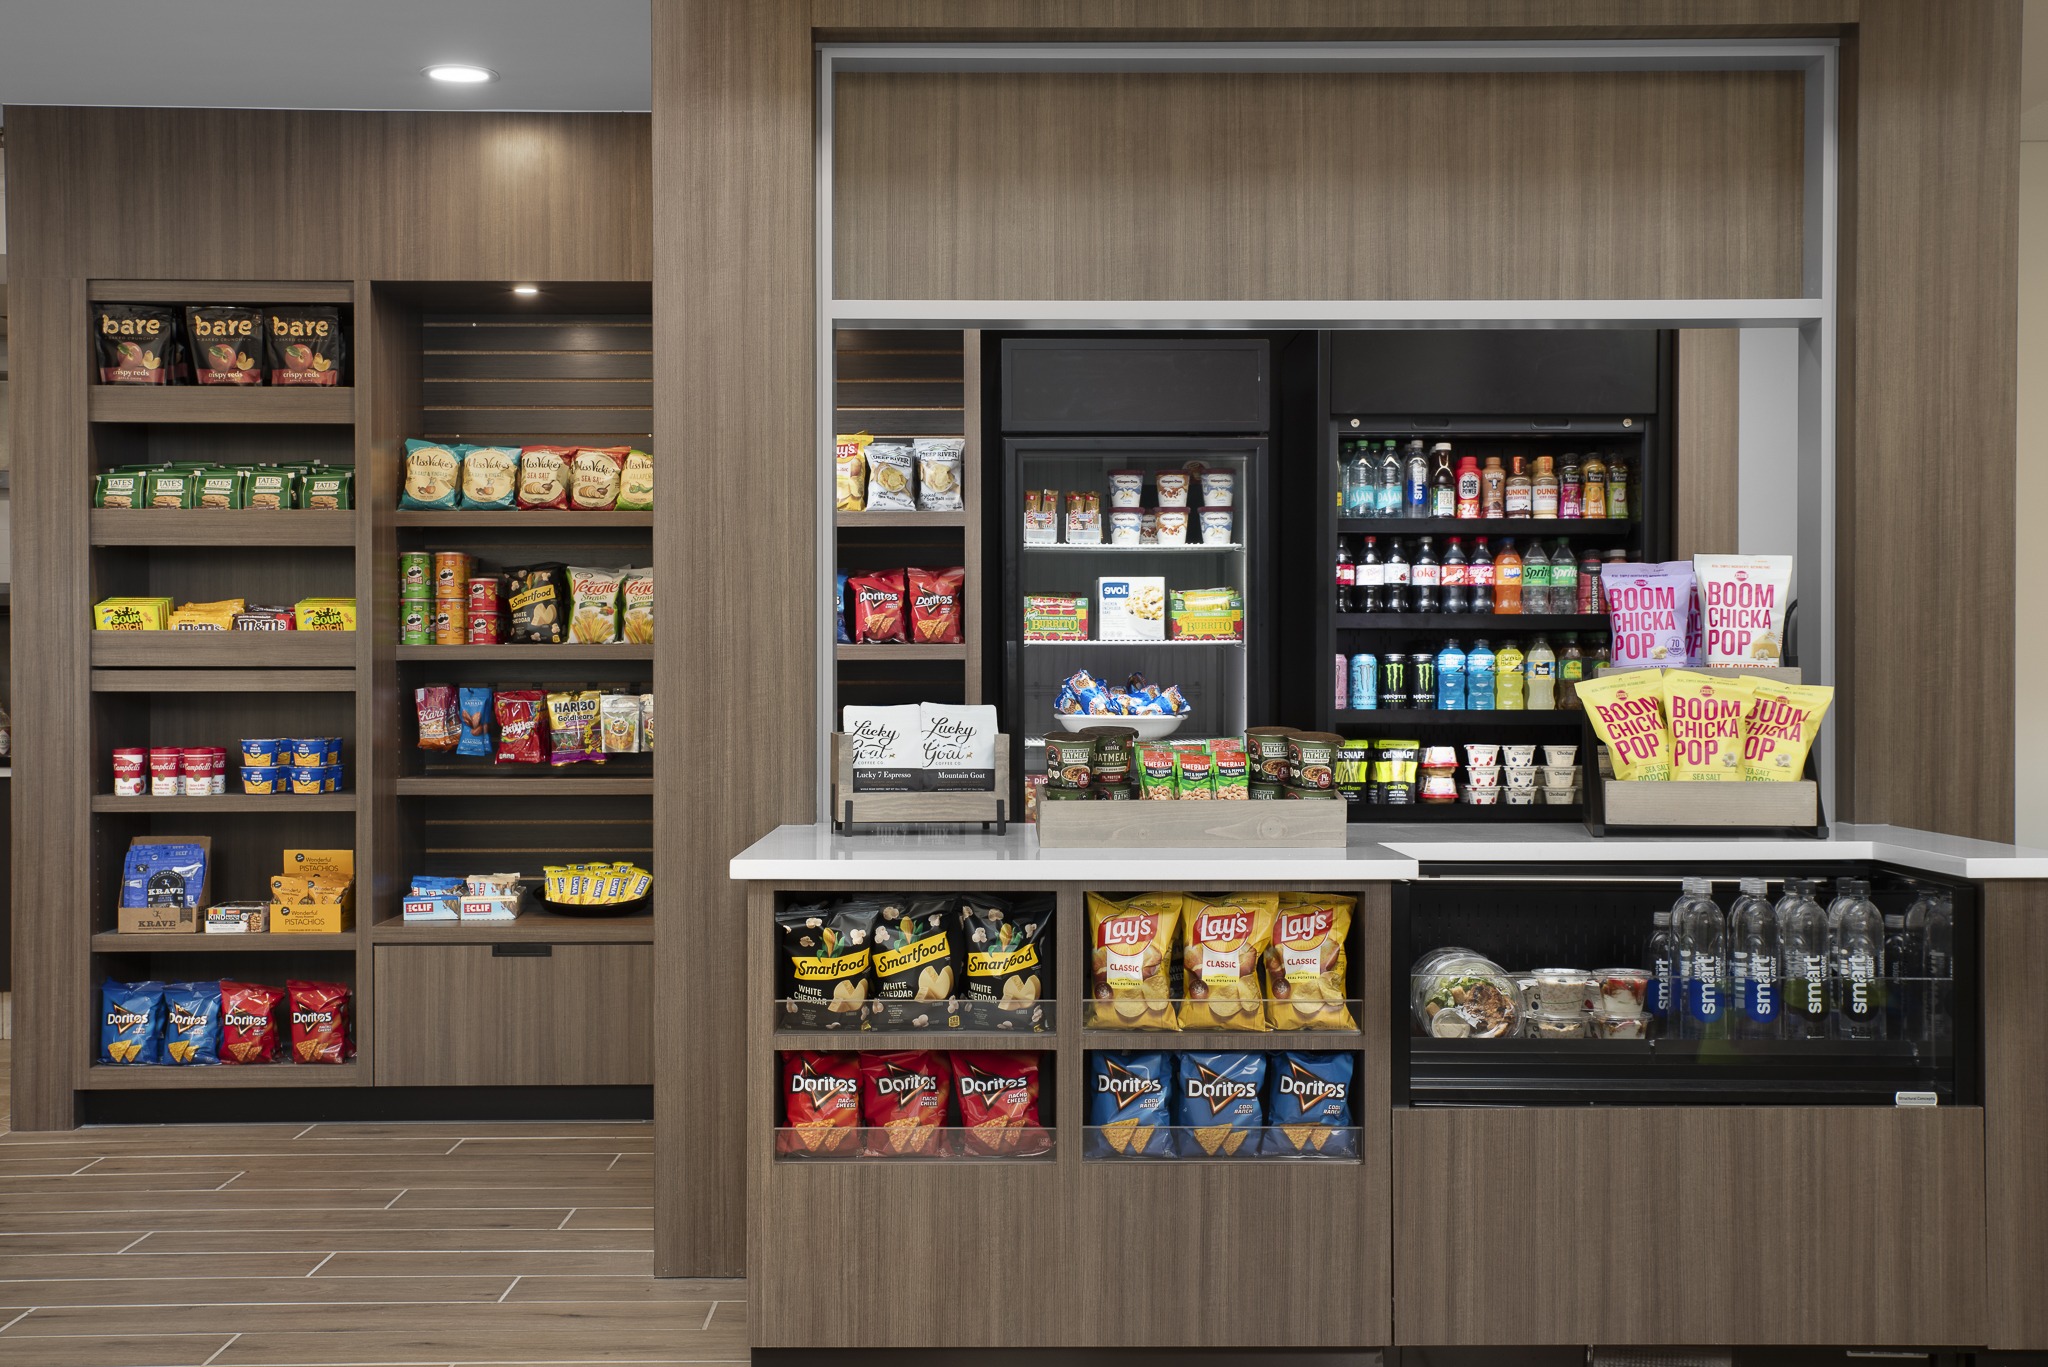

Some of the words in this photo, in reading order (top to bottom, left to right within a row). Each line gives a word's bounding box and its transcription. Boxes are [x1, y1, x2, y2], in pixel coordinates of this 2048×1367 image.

[102, 314, 160, 335] bare
[195, 315, 252, 336] bare
[273, 316, 329, 337] bare
[409, 455, 428, 467] Miss
[427, 454, 454, 470] Vickie's
[538, 472, 550, 480] SALT
[1462, 480, 1477, 488] CORE
[1412, 567, 1436, 578] Coke
[572, 579, 619, 595] Veggie
[1104, 585, 1128, 595] evol.
[1708, 582, 1774, 608] BOOM
[512, 588, 552, 608] Smartfood
[860, 592, 898, 603] Doritos
[916, 595, 953, 606] Doritos
[1610, 587, 1675, 612] BOOM
[112, 614, 141, 624] SOUR
[112, 622, 144, 630] PATCH
[313, 614, 341, 624] SOUR
[1031, 619, 1077, 630] BURRITO
[1613, 611, 1676, 633] CHICKA
[1708, 607, 1771, 629] CHICKA
[1187, 622, 1232, 632] BURRITO
[1615, 632, 1655, 661] POP
[1672, 638, 1680, 648] 70
[1708, 630, 1750, 656] POP
[419, 709, 445, 720] Kar's
[554, 700, 596, 713] HARIBO
[1595, 696, 1660, 724] BOOM
[1672, 696, 1741, 720] BOOM
[853, 720, 900, 746] Lucky
[924, 717, 977, 744] Lucky
[1672, 718, 1740, 739] CHICKA
[853, 739, 888, 765] Goat
[1344, 751, 1365, 759] SNAP!
[1382, 751, 1392, 759] OH
[1393, 751, 1415, 759] SNAP!
[1614, 733, 1660, 766] POP
[1674, 740, 1719, 767] POP
[1744, 736, 1776, 761] OP
[1094, 752, 1128, 762] OATMEAL
[856, 771, 876, 779] Lucky
[883, 771, 912, 779] Espresso
[938, 771, 969, 779] Mountain
[970, 771, 986, 779] Goat
[1692, 773, 1705, 781] SEA
[1706, 773, 1721, 781] SALT
[1754, 767, 1770, 776] SALT
[148, 888, 184, 896] KRAVE
[634, 876, 649, 895] LUNA
[412, 904, 432, 912] CLIF
[470, 904, 490, 912] CLIF
[1104, 914, 1152, 945] Lay's
[1200, 912, 1248, 942] Lay's
[1280, 910, 1327, 942] Lay's
[878, 938, 946, 972] Smartfood
[968, 948, 1032, 972] Smartfood
[1287, 958, 1316, 966] CLASSIC
[798, 954, 865, 976] Smartfood
[1110, 963, 1139, 972] CLASSIC
[1206, 960, 1236, 968] CLASSIC
[798, 984, 822, 996] WHITE
[883, 981, 907, 990] WHITE
[970, 982, 992, 994] WHITE
[1656, 959, 1669, 1010] smart
[1701, 956, 1716, 1015] smart
[1756, 956, 1770, 1015] smart
[1807, 955, 1822, 1014] smart
[1853, 956, 1867, 1015] smart
[794, 991, 828, 1006] CHEDDAR
[879, 990, 913, 998] CHEDDAR
[968, 991, 998, 1004] CHEDDAR
[108, 1014, 148, 1024] Doritos
[225, 1014, 267, 1026] Doritos
[293, 1012, 332, 1024] Doritos
[792, 1074, 857, 1092] Doritos
[879, 1074, 936, 1094] Doritos
[961, 1076, 1027, 1095] Doritos
[1098, 1074, 1161, 1092] Doritos
[1188, 1080, 1256, 1097] Doritos
[1280, 1076, 1345, 1098] Doritos
